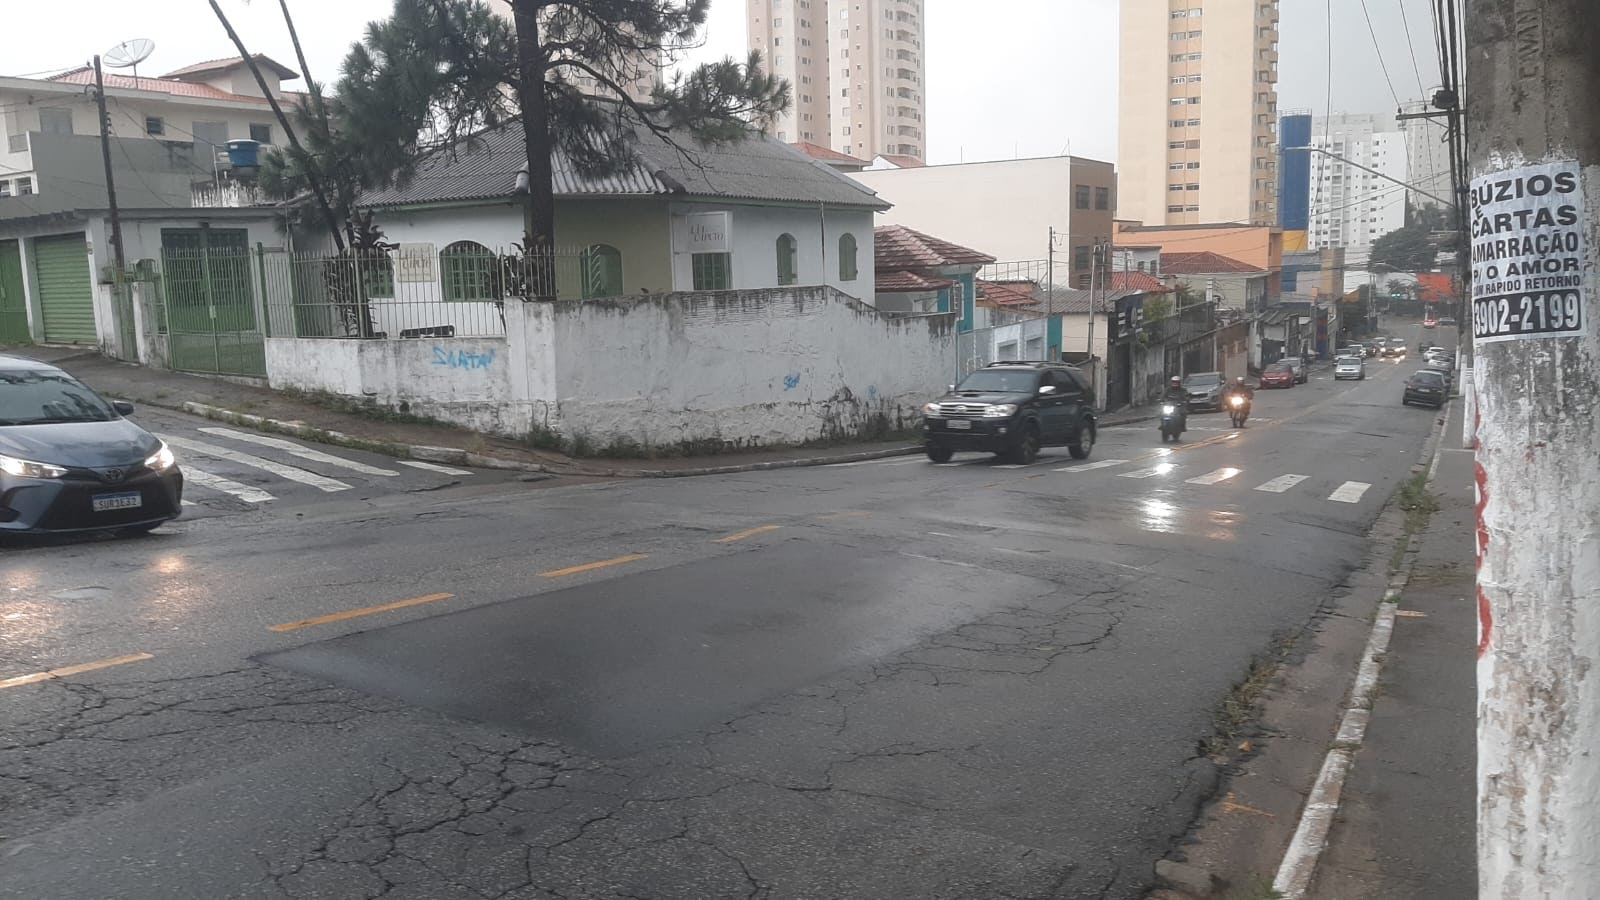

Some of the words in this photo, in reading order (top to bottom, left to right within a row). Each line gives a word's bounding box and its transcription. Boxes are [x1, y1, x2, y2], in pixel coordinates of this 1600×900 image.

[1471, 172, 1576, 209] BÚZIOS
[1472, 205, 1578, 239] CARTAS
[1475, 205, 1484, 220] E
[1472, 230, 1579, 265] AMARRAÇÃO
[1486, 265, 1499, 280] O
[1506, 257, 1580, 277] AMOR
[1525, 274, 1580, 290] RETORNO
[1474, 293, 1580, 336] 3902-2199
